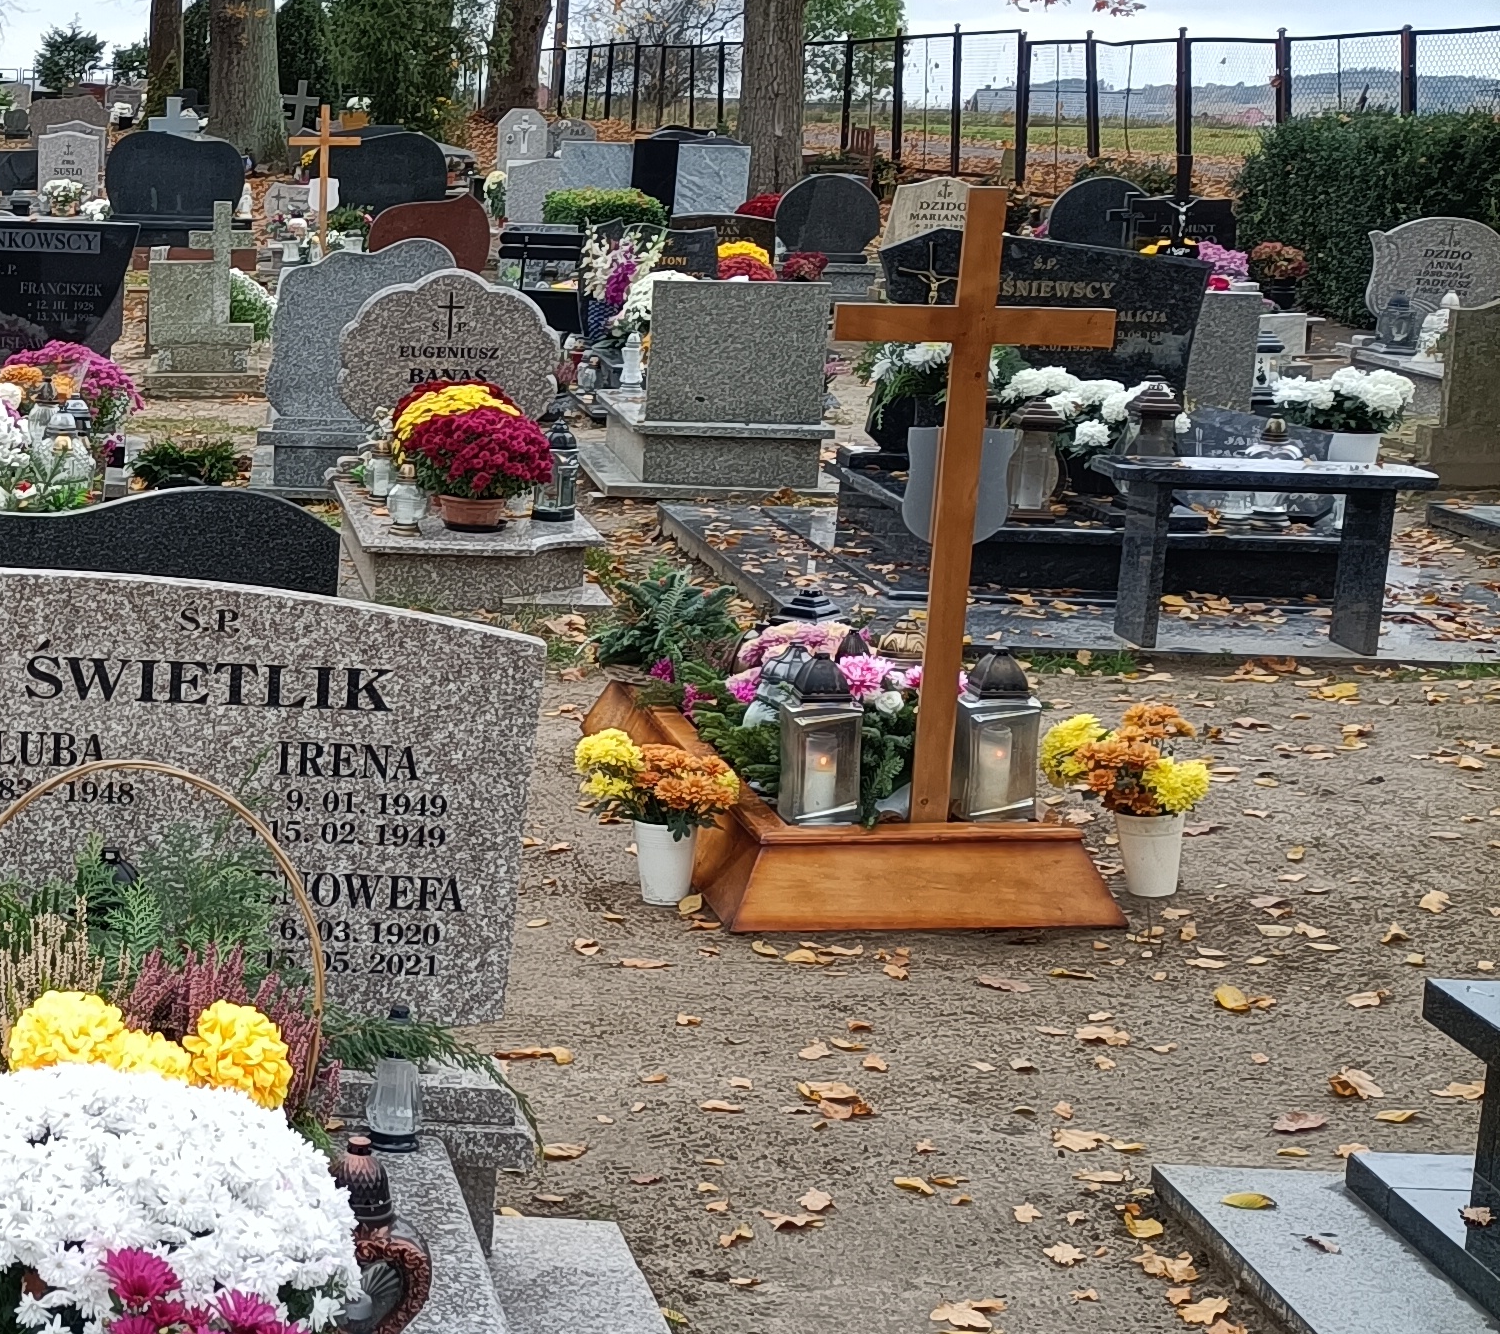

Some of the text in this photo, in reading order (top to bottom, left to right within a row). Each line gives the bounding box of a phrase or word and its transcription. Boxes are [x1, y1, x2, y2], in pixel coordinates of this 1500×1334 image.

[909, 212, 967, 222] MARIANN
[718, 226, 741, 235] JAN
[1422, 248, 1473, 260] DZIDO
[1426, 260, 1463, 271] ANNA
[19, 281, 103, 297] FRANCISZEK
[998, 271, 1116, 299] IŚNIEWSCY
[399, 345, 501, 361] EUGENIUSZ
[24, 639, 394, 712] ŚWIETLIK
[276, 740, 422, 782] IRENA
[65, 779, 135, 806] 1948
[376, 791, 449, 818] 1949
[375, 823, 447, 849] 1949
[252, 869, 466, 913] ENOWEFA
[370, 921, 441, 946] 1920
[367, 952, 437, 977] 2021
